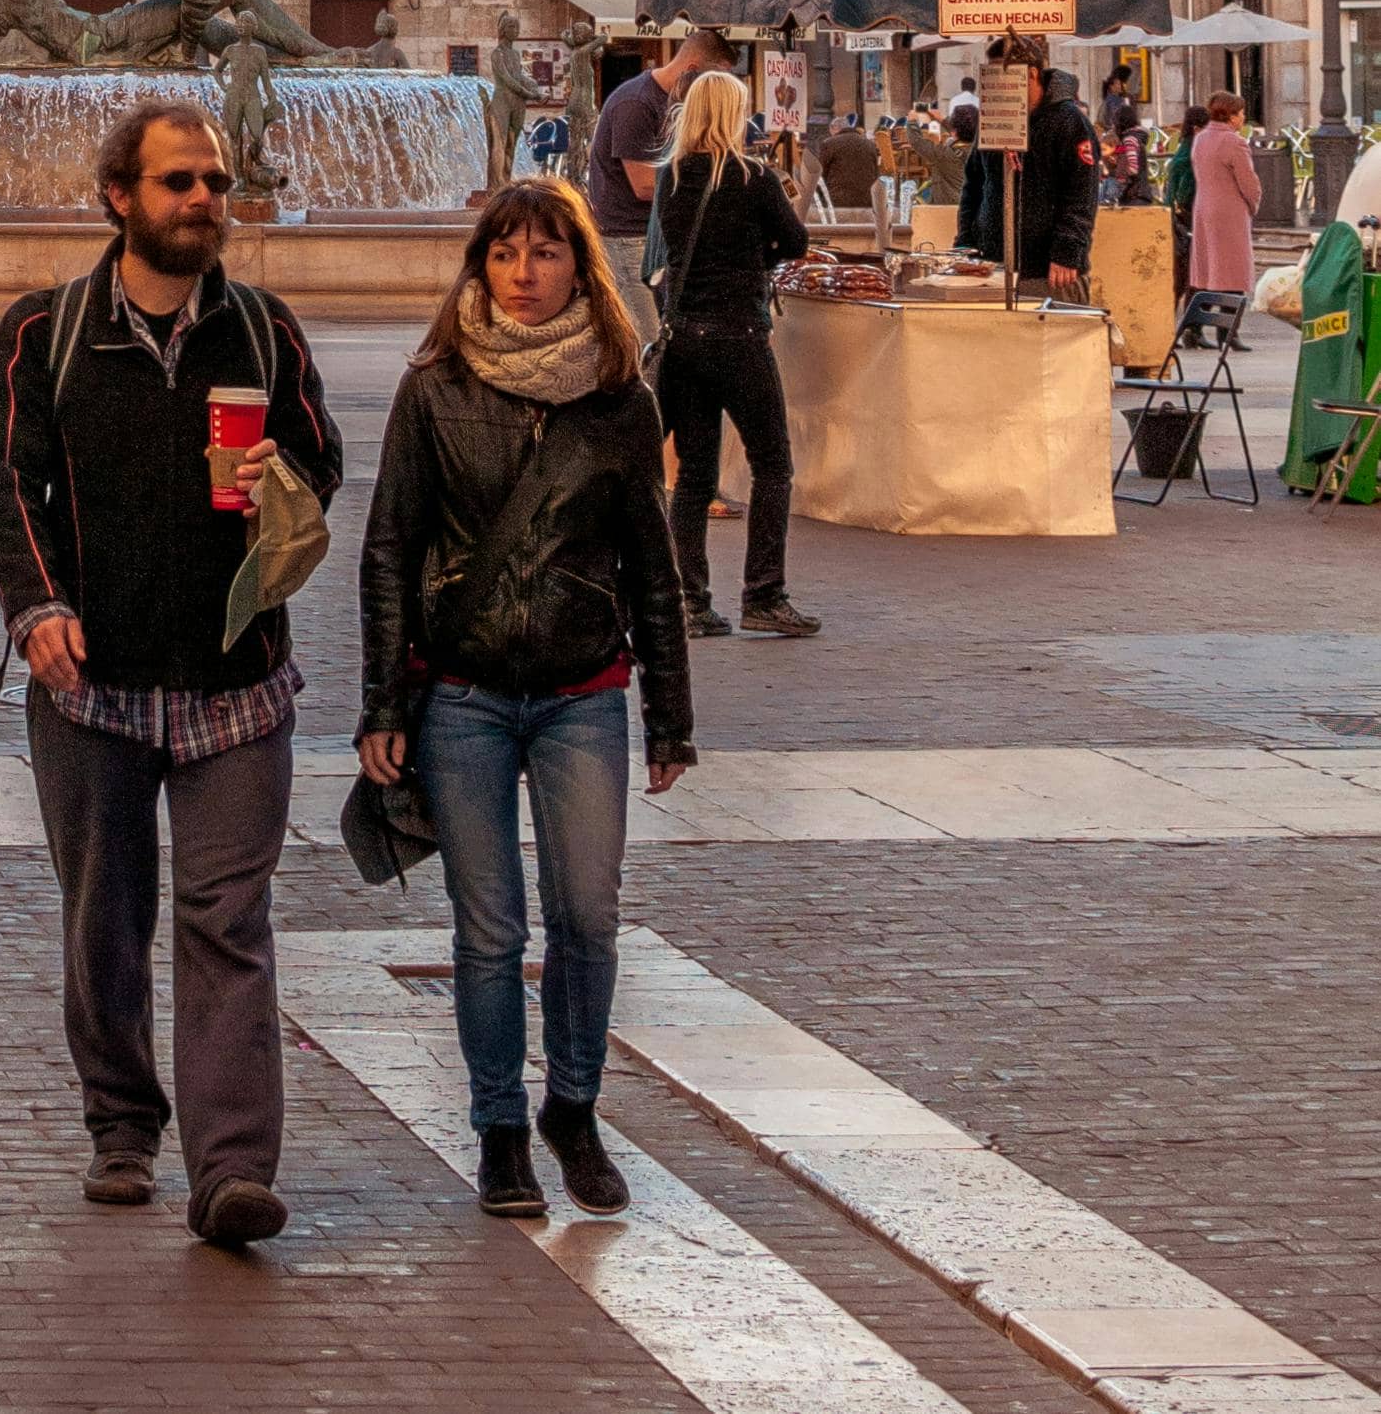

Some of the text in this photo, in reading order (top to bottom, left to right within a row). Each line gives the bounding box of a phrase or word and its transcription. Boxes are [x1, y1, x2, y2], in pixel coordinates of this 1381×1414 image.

[951, 12, 1063, 27] (RECIEN HECHAS)
[636, 25, 663, 36] TAPAS
[1316, 316, 1348, 334] ONCE
